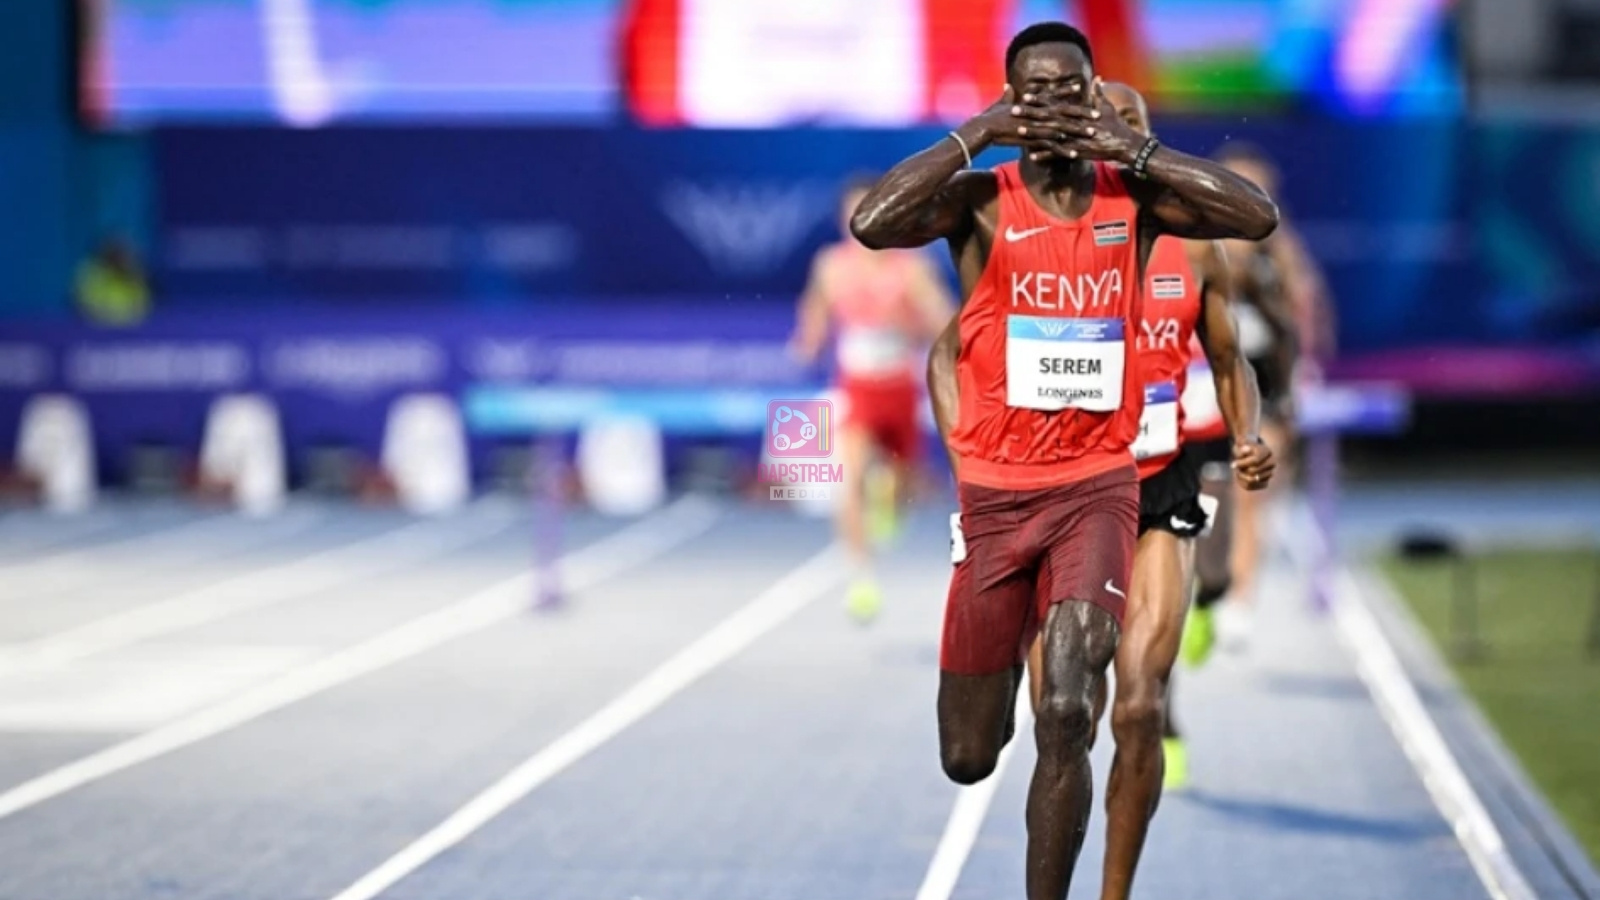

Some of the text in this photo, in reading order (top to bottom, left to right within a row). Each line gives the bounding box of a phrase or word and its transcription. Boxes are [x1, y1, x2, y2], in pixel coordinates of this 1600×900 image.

[1012, 268, 1122, 311] KENYA
[1039, 357, 1102, 375] SEREM
[1037, 386, 1103, 400] LONGINES
